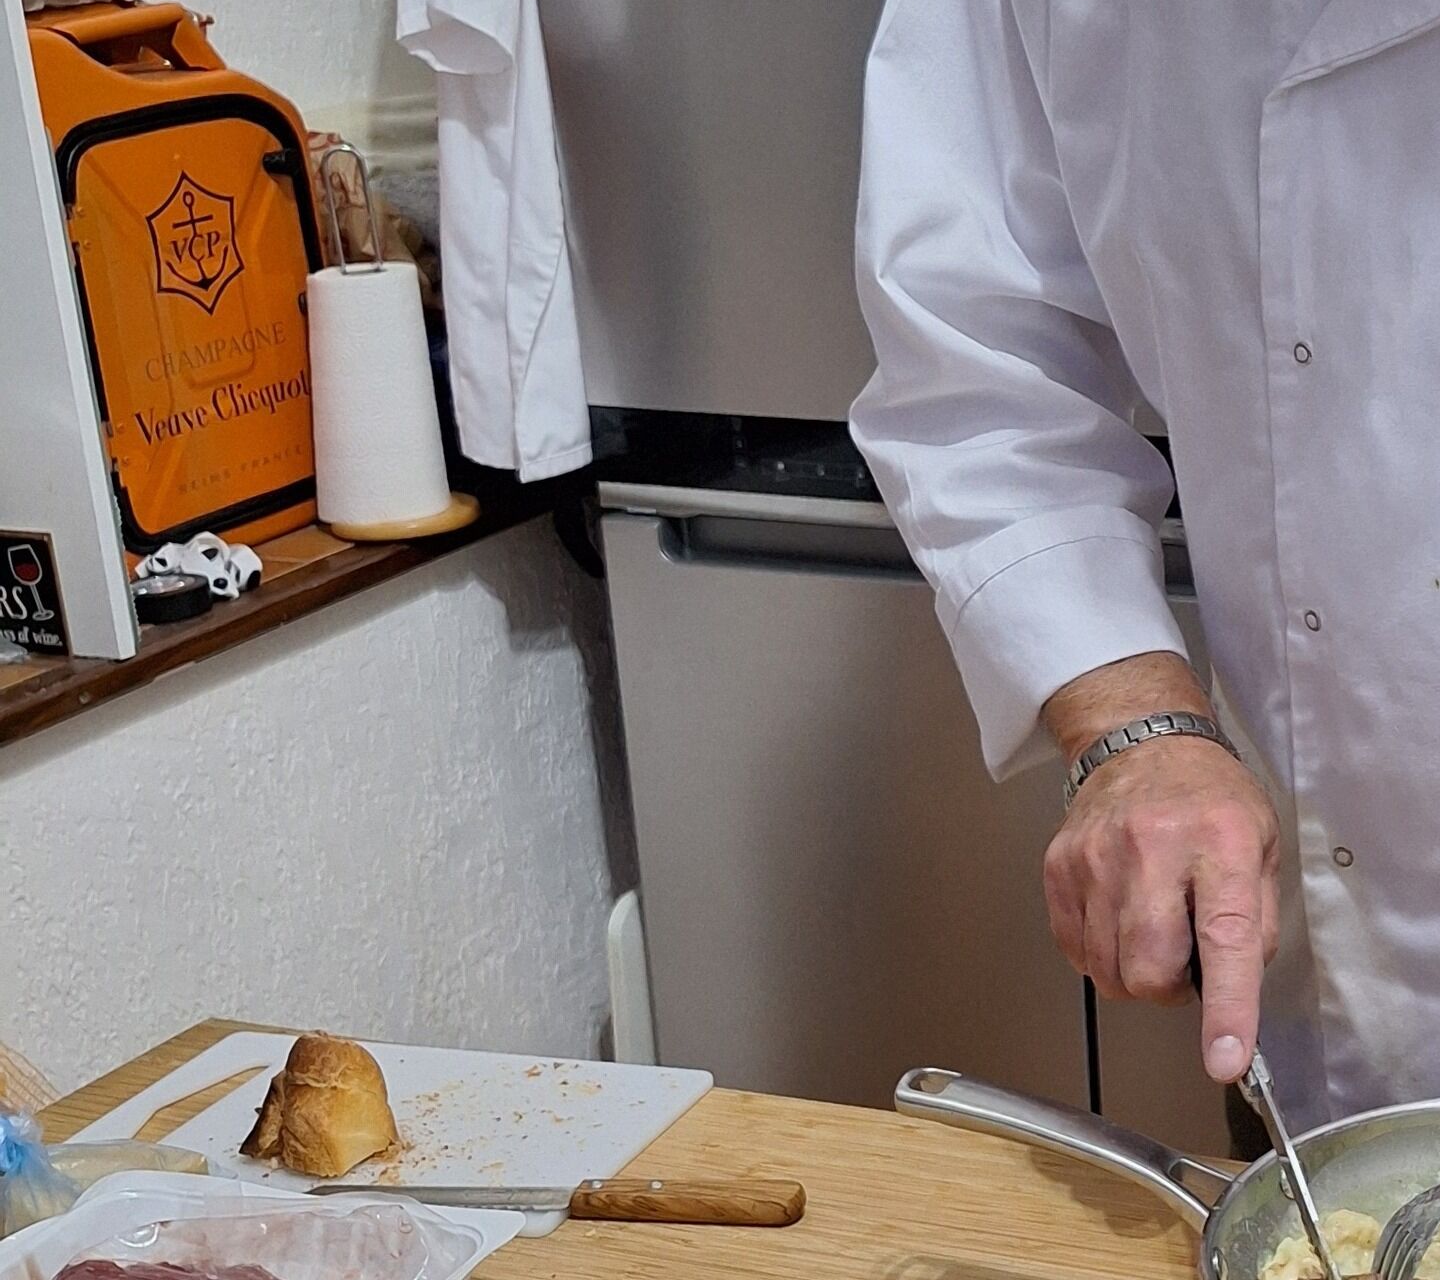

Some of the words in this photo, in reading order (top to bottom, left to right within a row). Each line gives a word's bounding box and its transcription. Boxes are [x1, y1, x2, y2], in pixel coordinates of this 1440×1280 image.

[170, 230, 222, 264] VCP
[145, 321, 287, 382] CHAMPAGNE
[134, 406, 209, 446] Veuve
[211, 369, 311, 422] Clicquot
